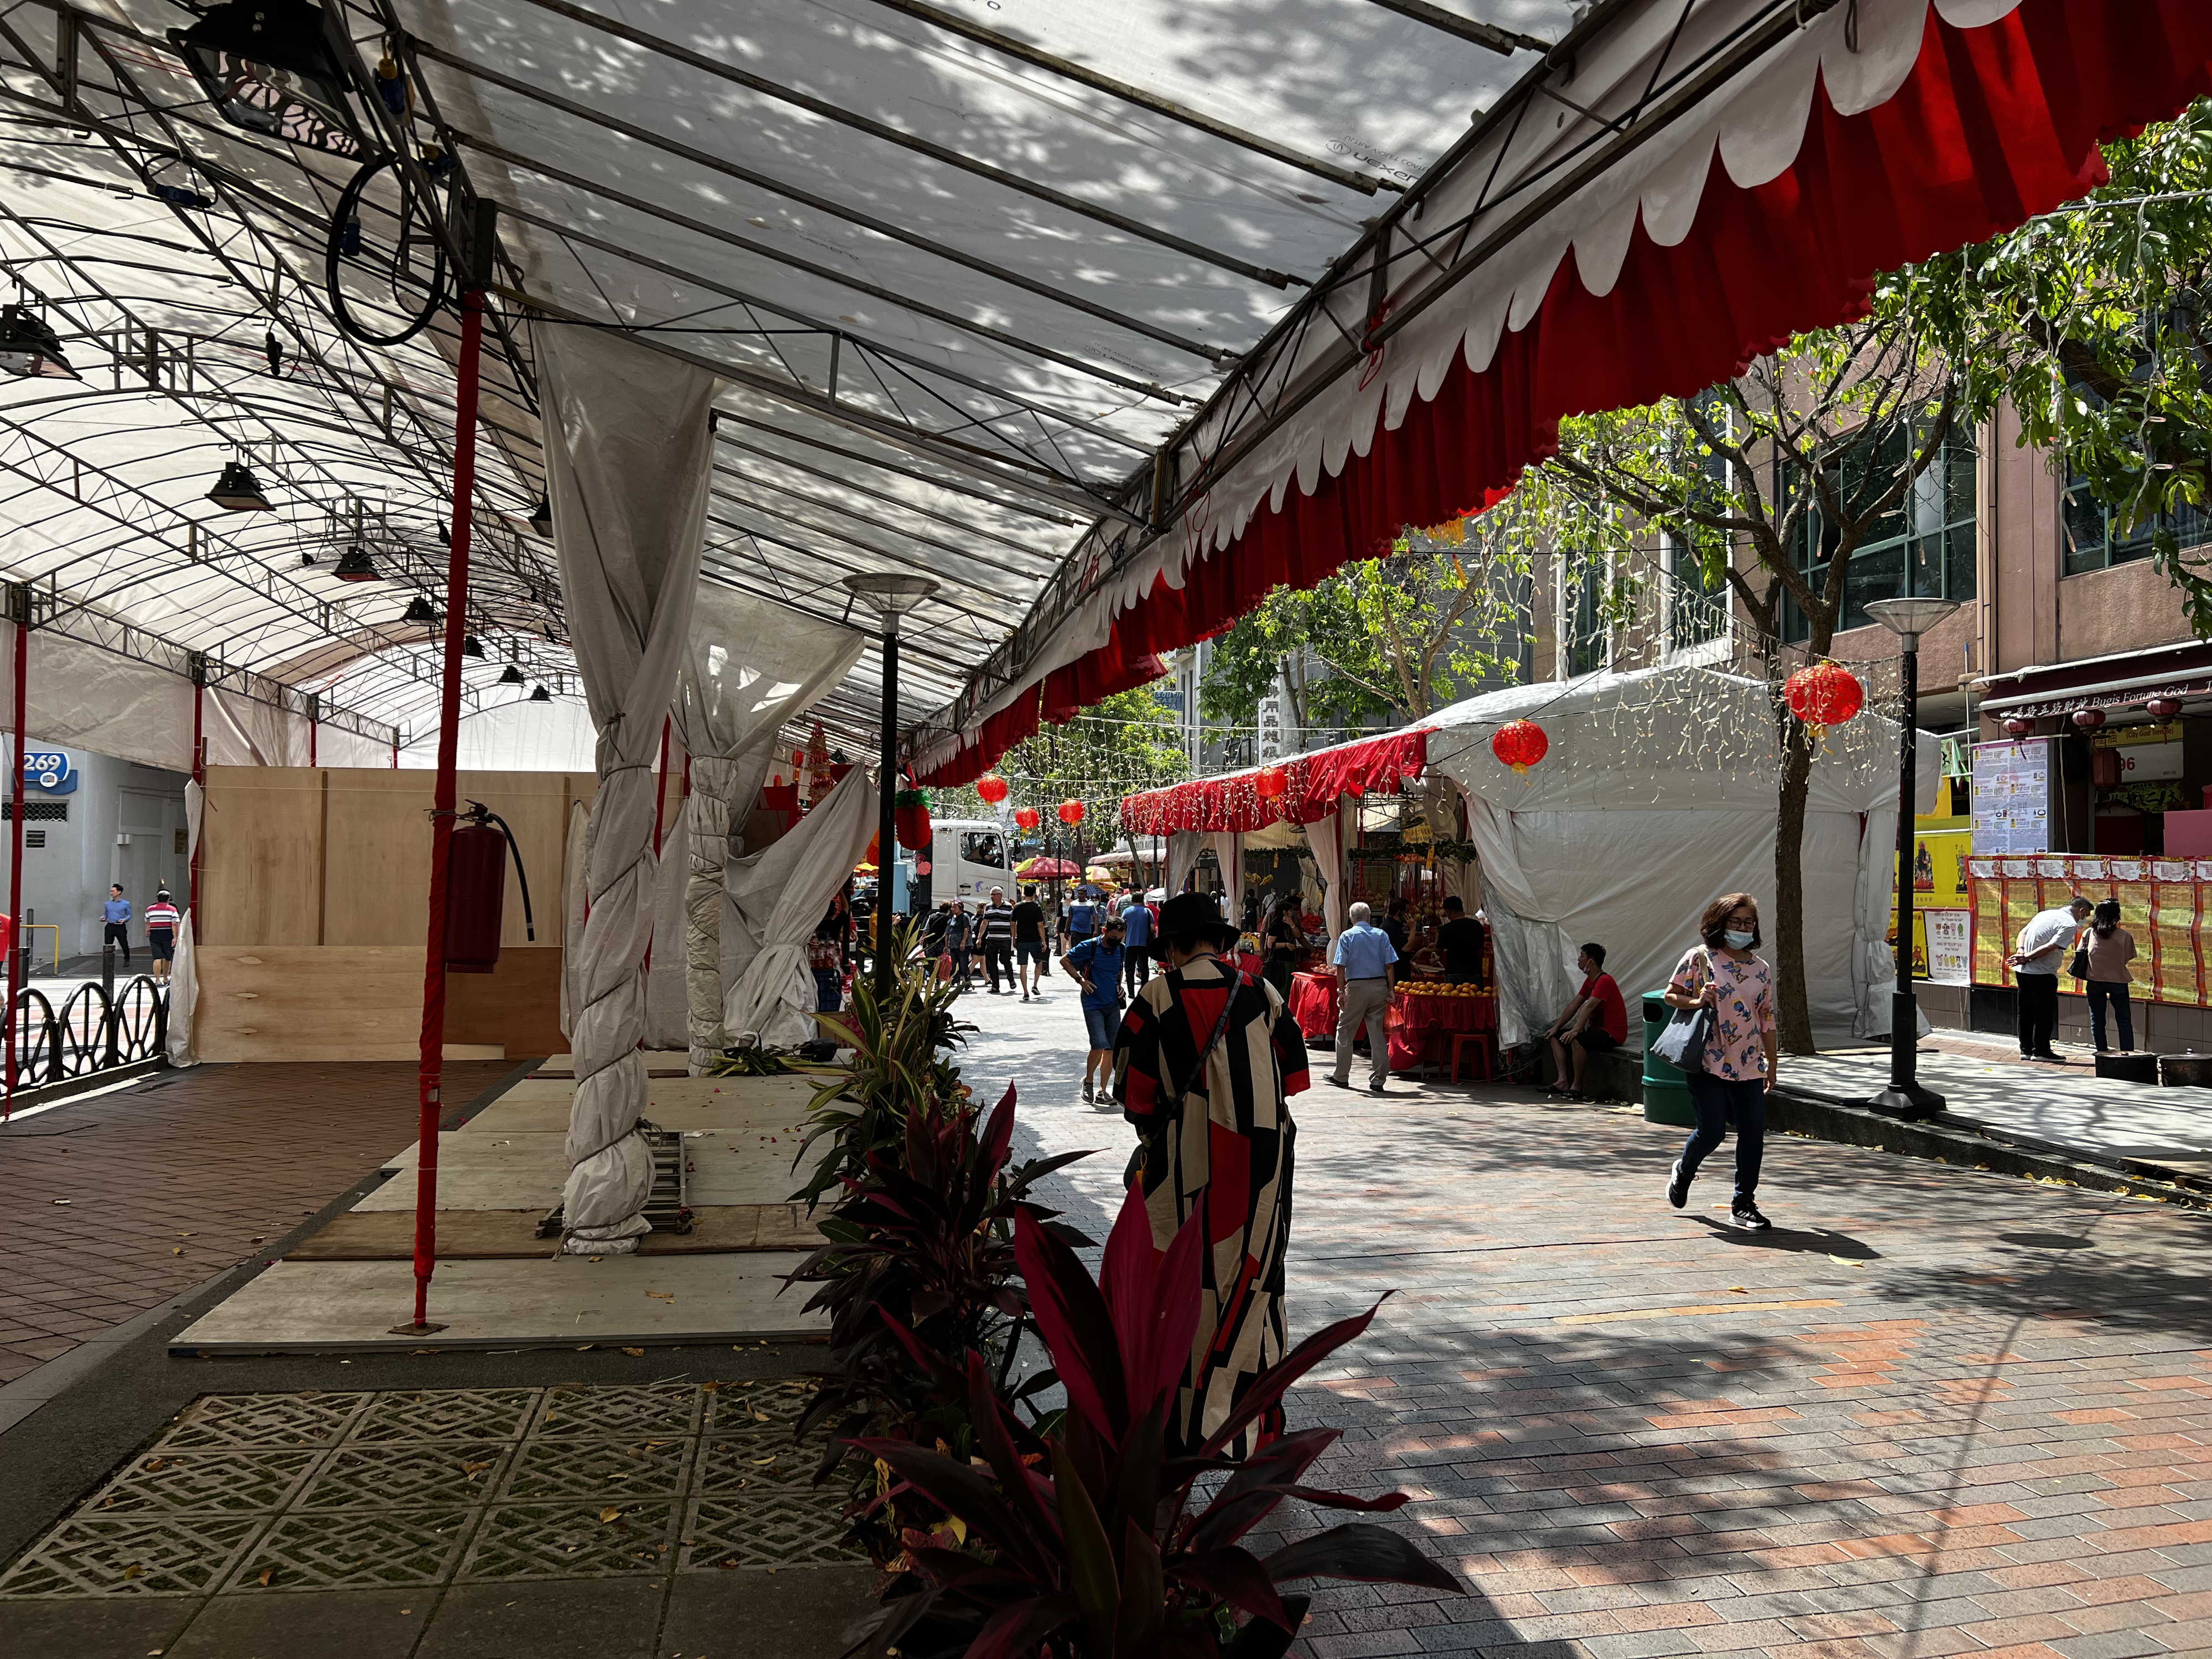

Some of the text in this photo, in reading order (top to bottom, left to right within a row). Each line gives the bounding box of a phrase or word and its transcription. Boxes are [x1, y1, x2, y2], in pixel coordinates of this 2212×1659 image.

[2090, 693, 2120, 708] Bugis
[2122, 691, 2161, 703] Fortune
[2163, 684, 2189, 697] God
[2152, 727, 2174, 735] Temle)
[24, 754, 61, 771] 269
